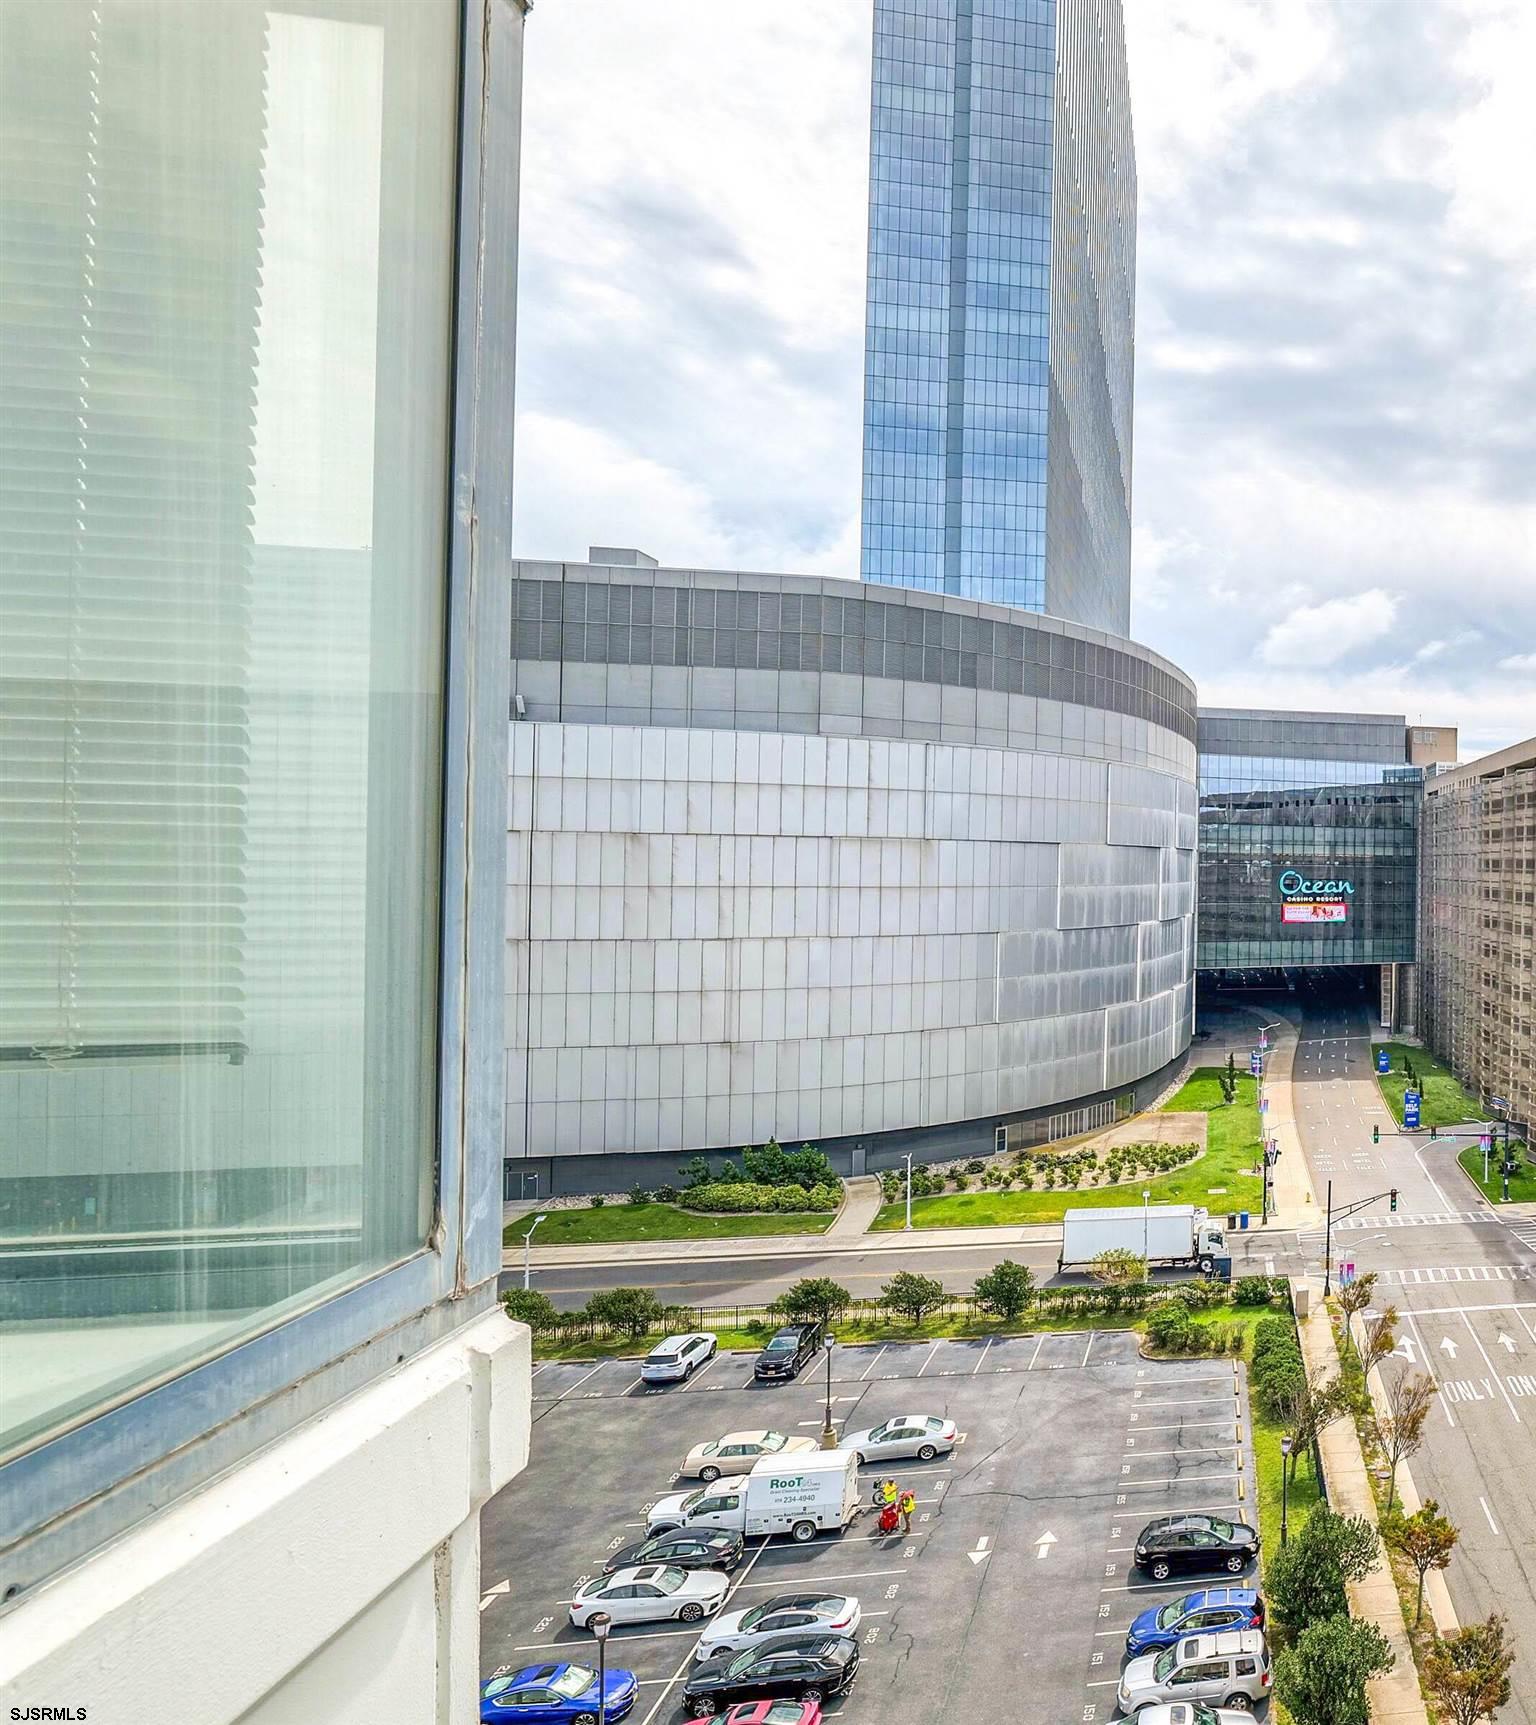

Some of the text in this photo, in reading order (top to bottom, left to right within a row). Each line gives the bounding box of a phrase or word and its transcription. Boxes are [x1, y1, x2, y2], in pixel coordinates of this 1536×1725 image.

[1280, 870, 1355, 895] Ocean
[1443, 1378, 1495, 1403] ONLY
[770, 1477, 804, 1489] RooT
[783, 1494, 815, 1504] 234-4940
[1105, 1563, 1116, 1577] 153
[1098, 1604, 1110, 1618] 152
[533, 1616, 554, 1632] 220
[863, 1627, 880, 1645] 208
[1091, 1652, 1104, 1665] 151
[1083, 1704, 1096, 1721] 150
